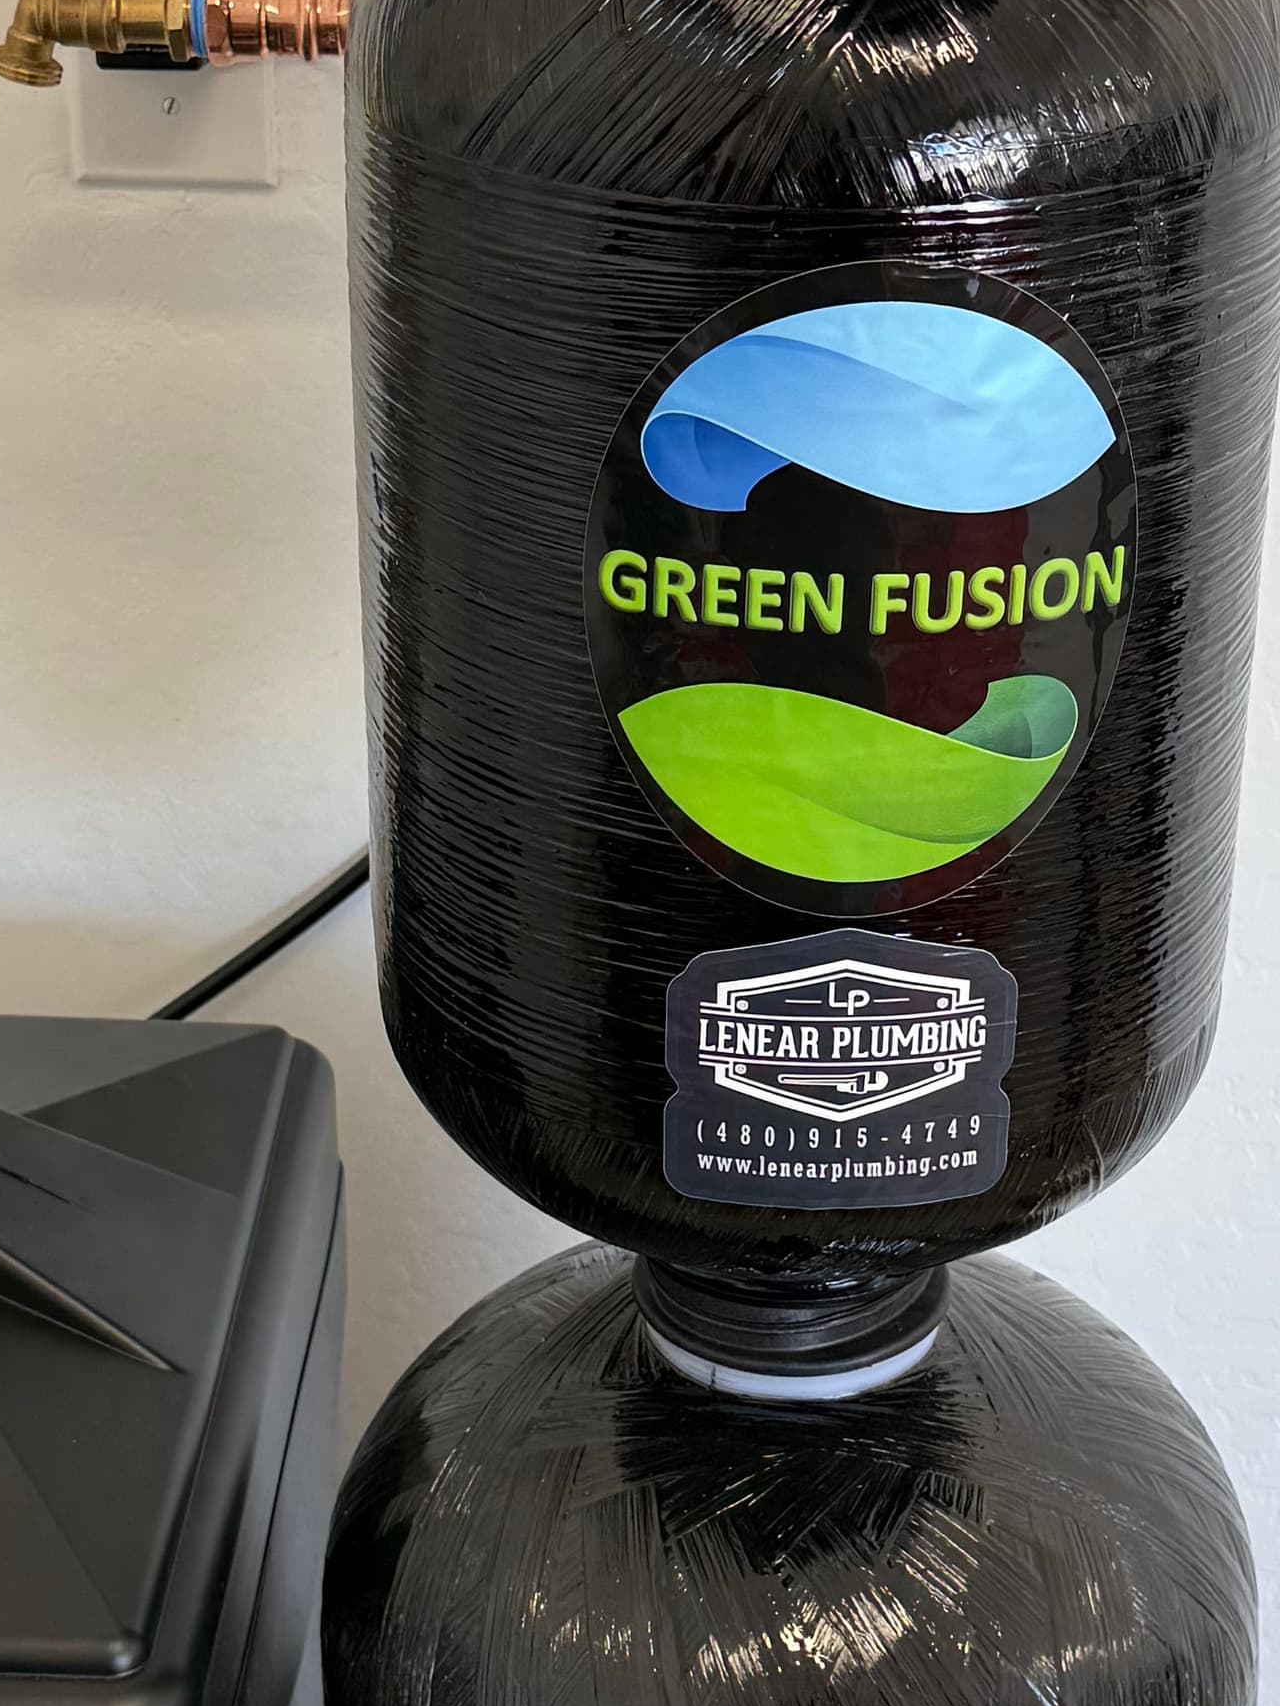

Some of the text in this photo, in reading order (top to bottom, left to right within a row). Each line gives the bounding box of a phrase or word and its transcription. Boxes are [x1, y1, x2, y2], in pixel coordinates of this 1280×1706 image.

[597, 544, 1125, 636] GREEN FUSION
[698, 1014, 987, 1060] LENEAR PLUMBING
[697, 1149, 978, 1183] www.lenearplumbing.com
